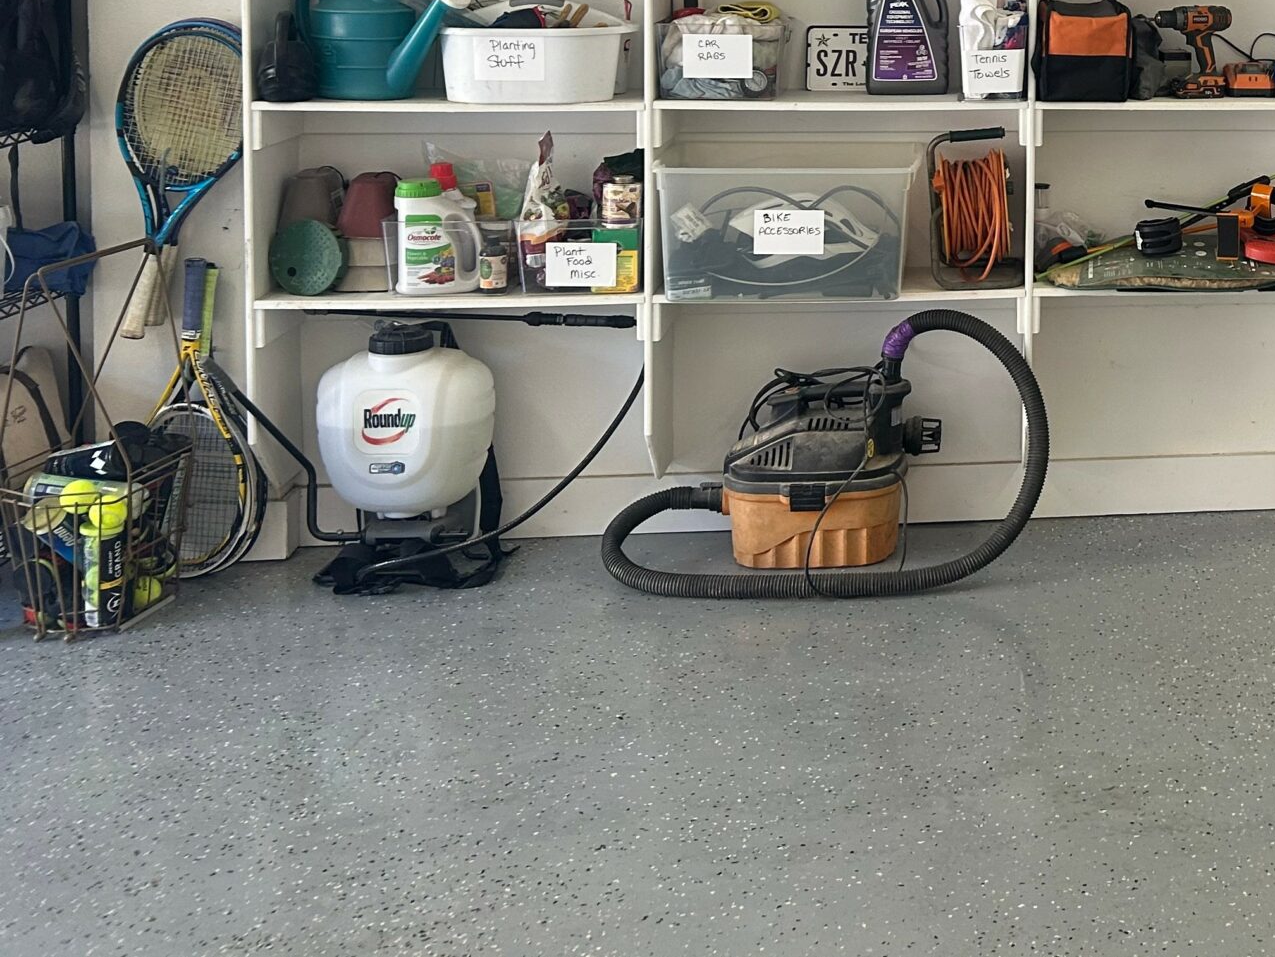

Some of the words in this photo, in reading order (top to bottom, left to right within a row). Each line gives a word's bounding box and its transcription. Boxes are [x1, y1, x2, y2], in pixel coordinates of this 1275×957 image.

[489, 39, 535, 59] Planting
[697, 39, 720, 49] CAR
[487, 54, 525, 69] Stuff
[697, 51, 726, 61] RAGS
[971, 54, 1008, 64] Tennis
[816, 49, 857, 77] SZR
[968, 67, 1011, 79] Towels
[763, 213, 791, 224] BIKE
[758, 226, 821, 236] ACCESSORIES
[553, 246, 587, 257] Plant
[567, 255, 593, 267] Food
[363, 408, 416, 433] Roundup
[114, 540, 122, 578] GRAND
